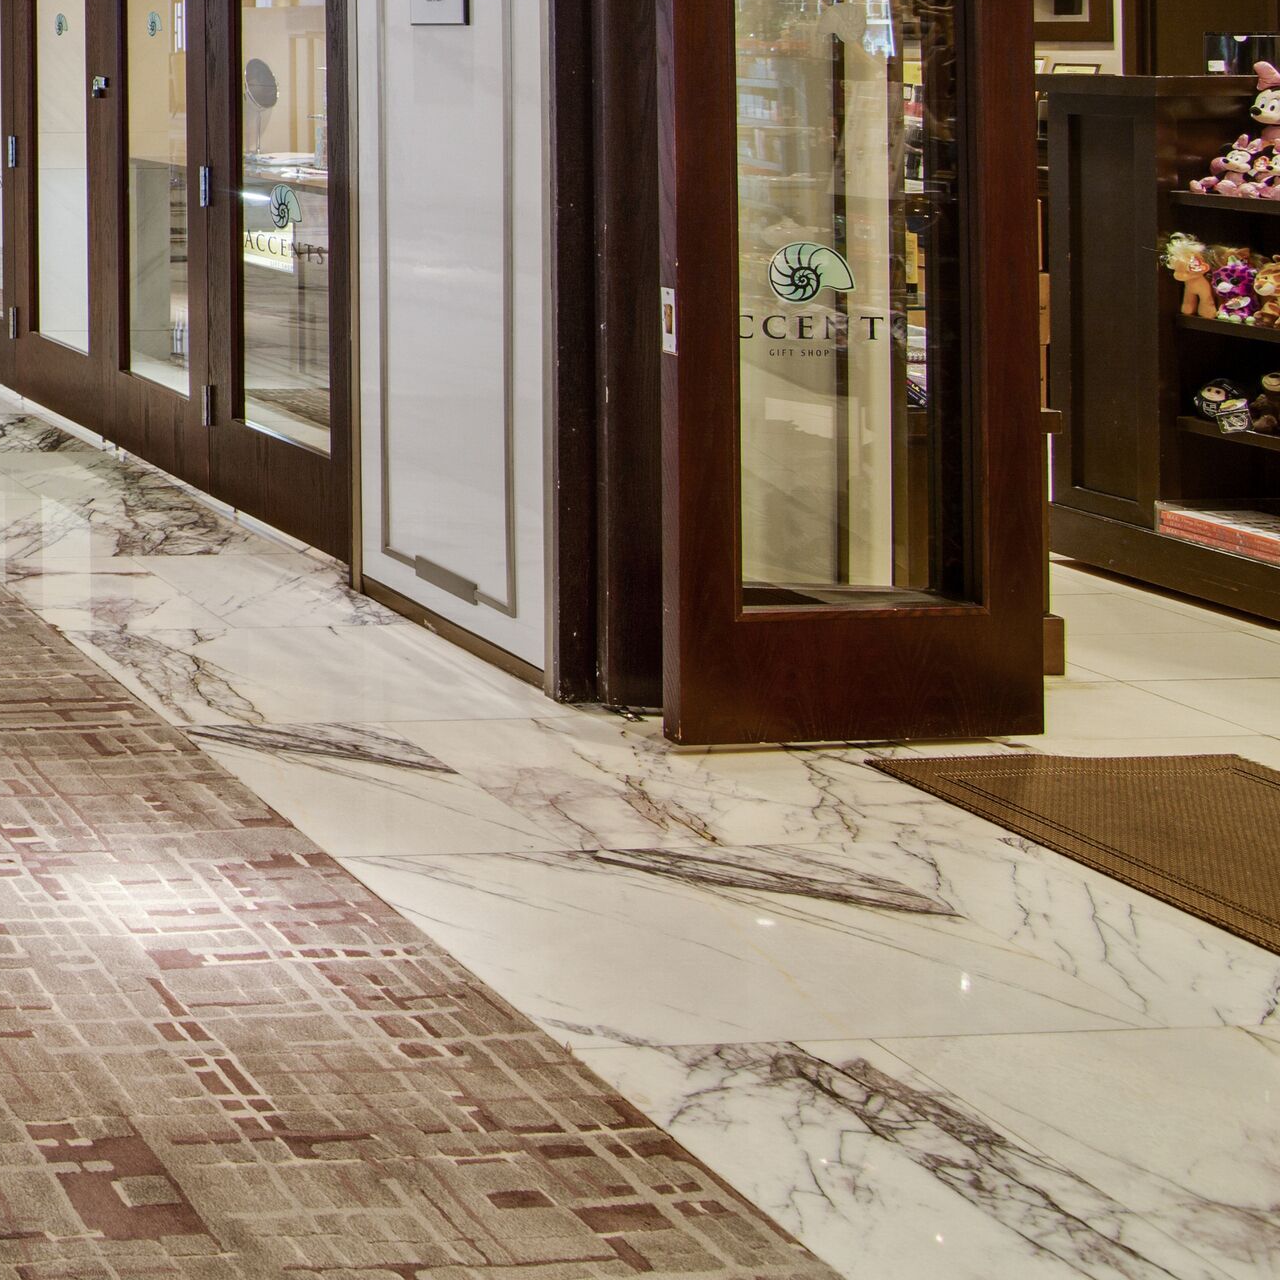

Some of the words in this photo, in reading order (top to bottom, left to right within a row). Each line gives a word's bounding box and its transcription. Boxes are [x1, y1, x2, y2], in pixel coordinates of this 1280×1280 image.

[244, 229, 324, 265] ACCENTS
[769, 348, 794, 357] GIFT
[800, 348, 830, 357] SHOP
